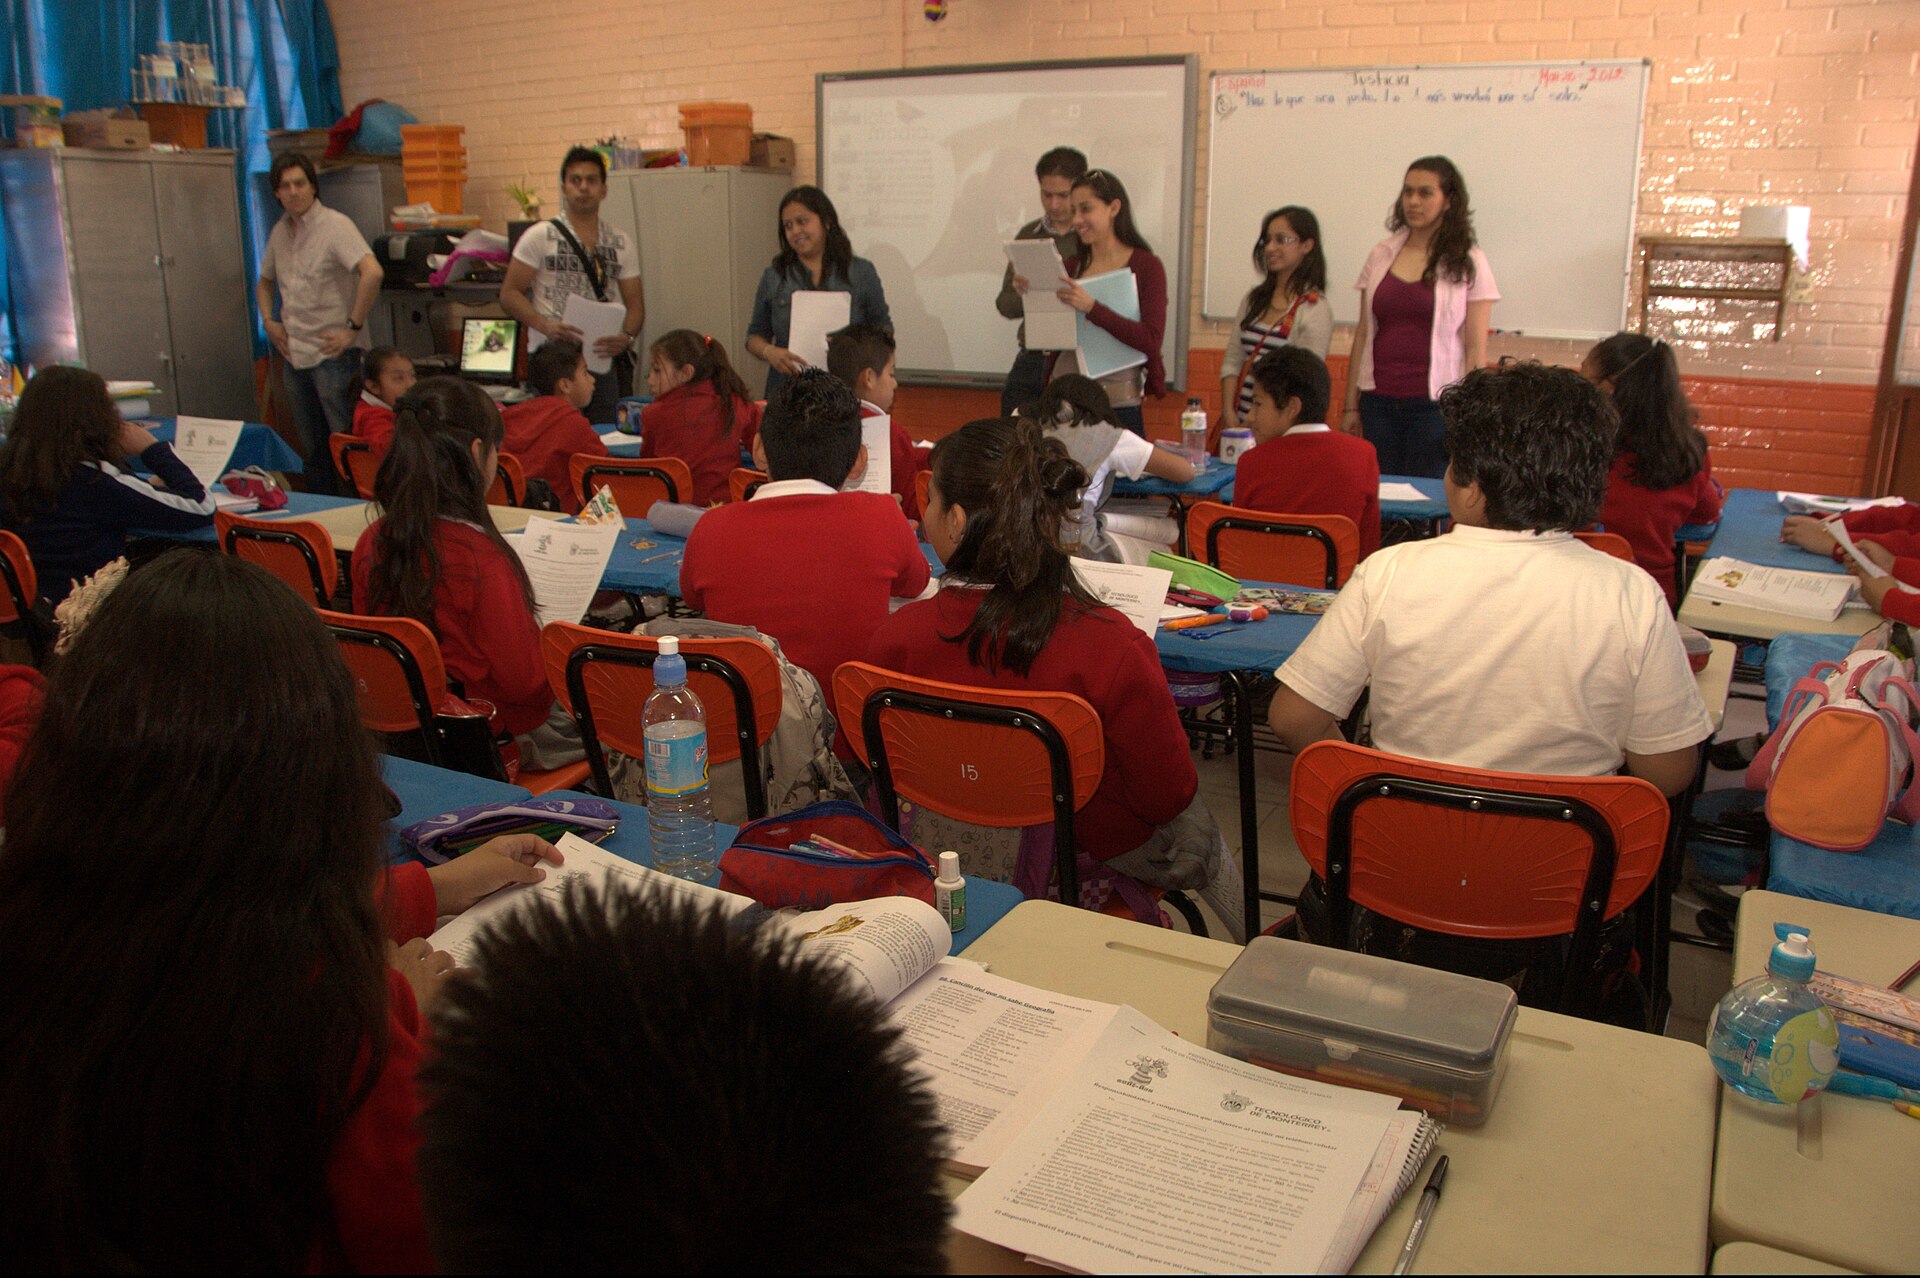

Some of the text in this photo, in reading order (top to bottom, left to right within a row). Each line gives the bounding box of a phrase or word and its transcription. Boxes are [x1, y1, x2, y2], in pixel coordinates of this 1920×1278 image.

[960, 764, 978, 780] 15
[950, 978, 973, 989] Canción
[986, 990, 997, 998] que
[1008, 997, 1023, 1006] sabe
[1254, 1106, 1322, 1124] TECNOLÓGICO
[1266, 1114, 1327, 1130] MONTERREY
[1314, 1142, 1337, 1150] celular
